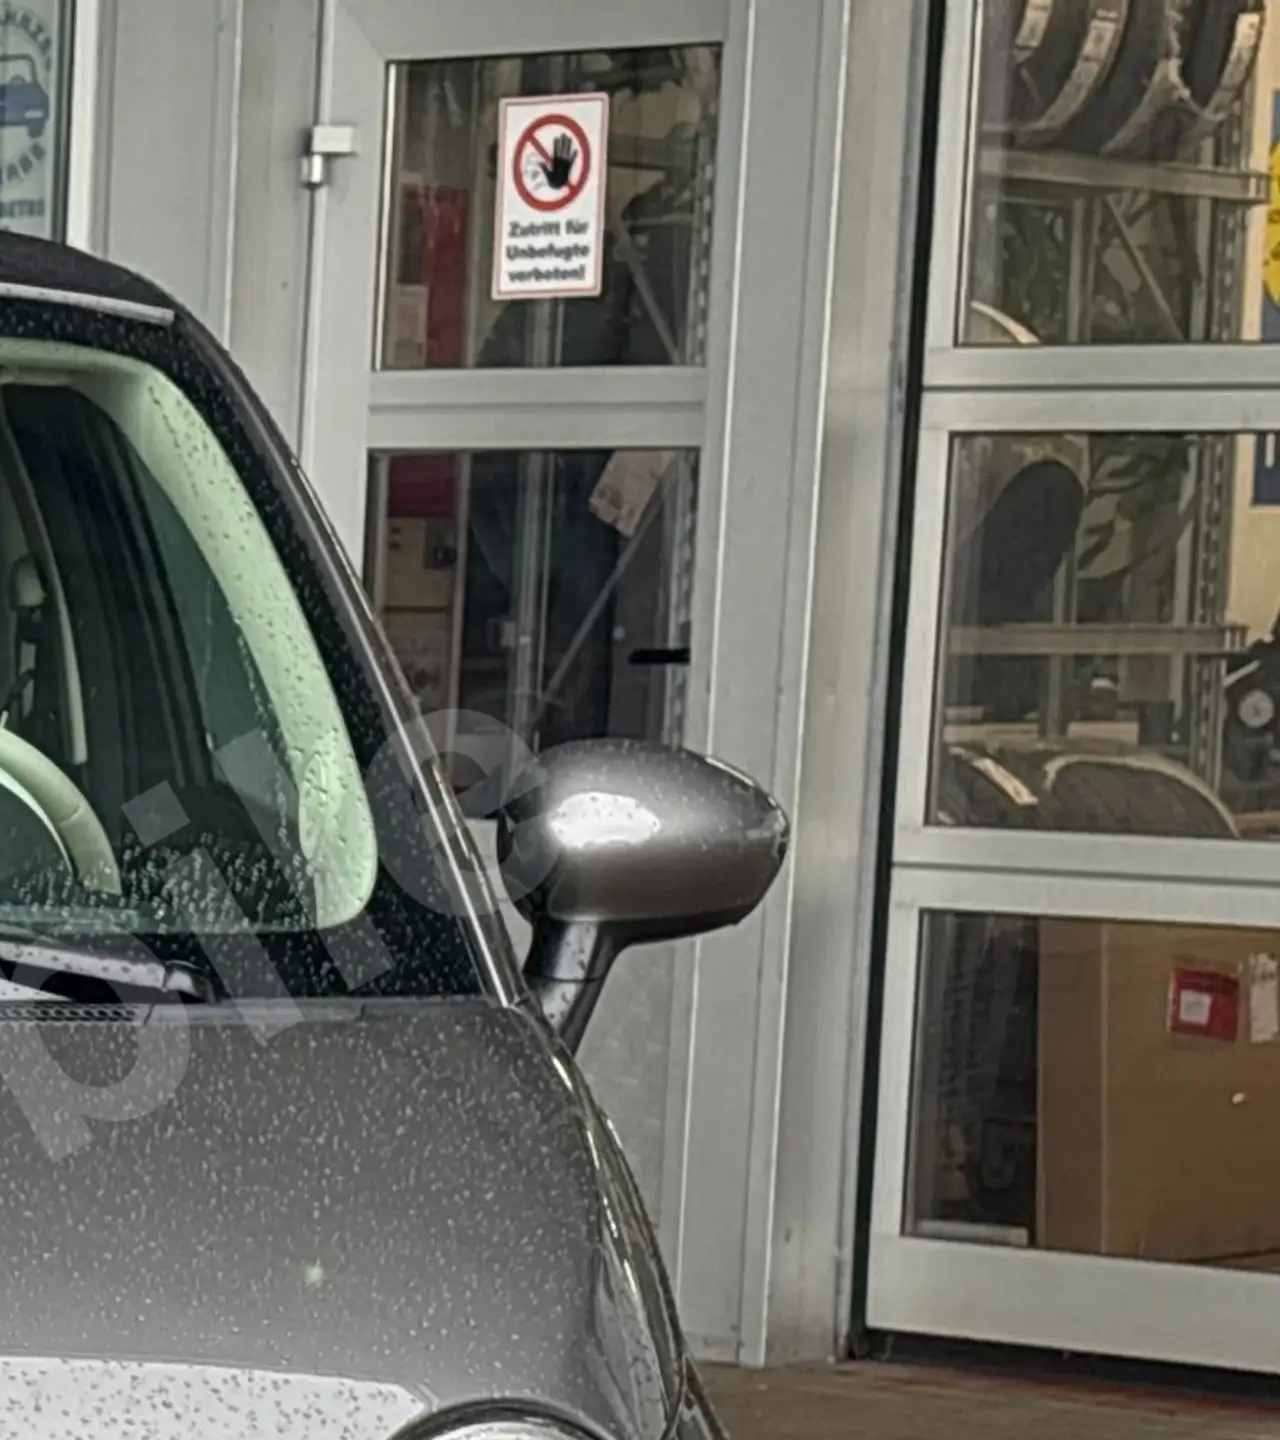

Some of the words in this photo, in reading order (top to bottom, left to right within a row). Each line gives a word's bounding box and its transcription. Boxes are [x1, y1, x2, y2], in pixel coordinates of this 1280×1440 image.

[508, 221, 561, 238] Zutritt
[565, 219, 589, 235] für
[506, 243, 590, 262] Unbefugte
[508, 264, 586, 283] verboten!
